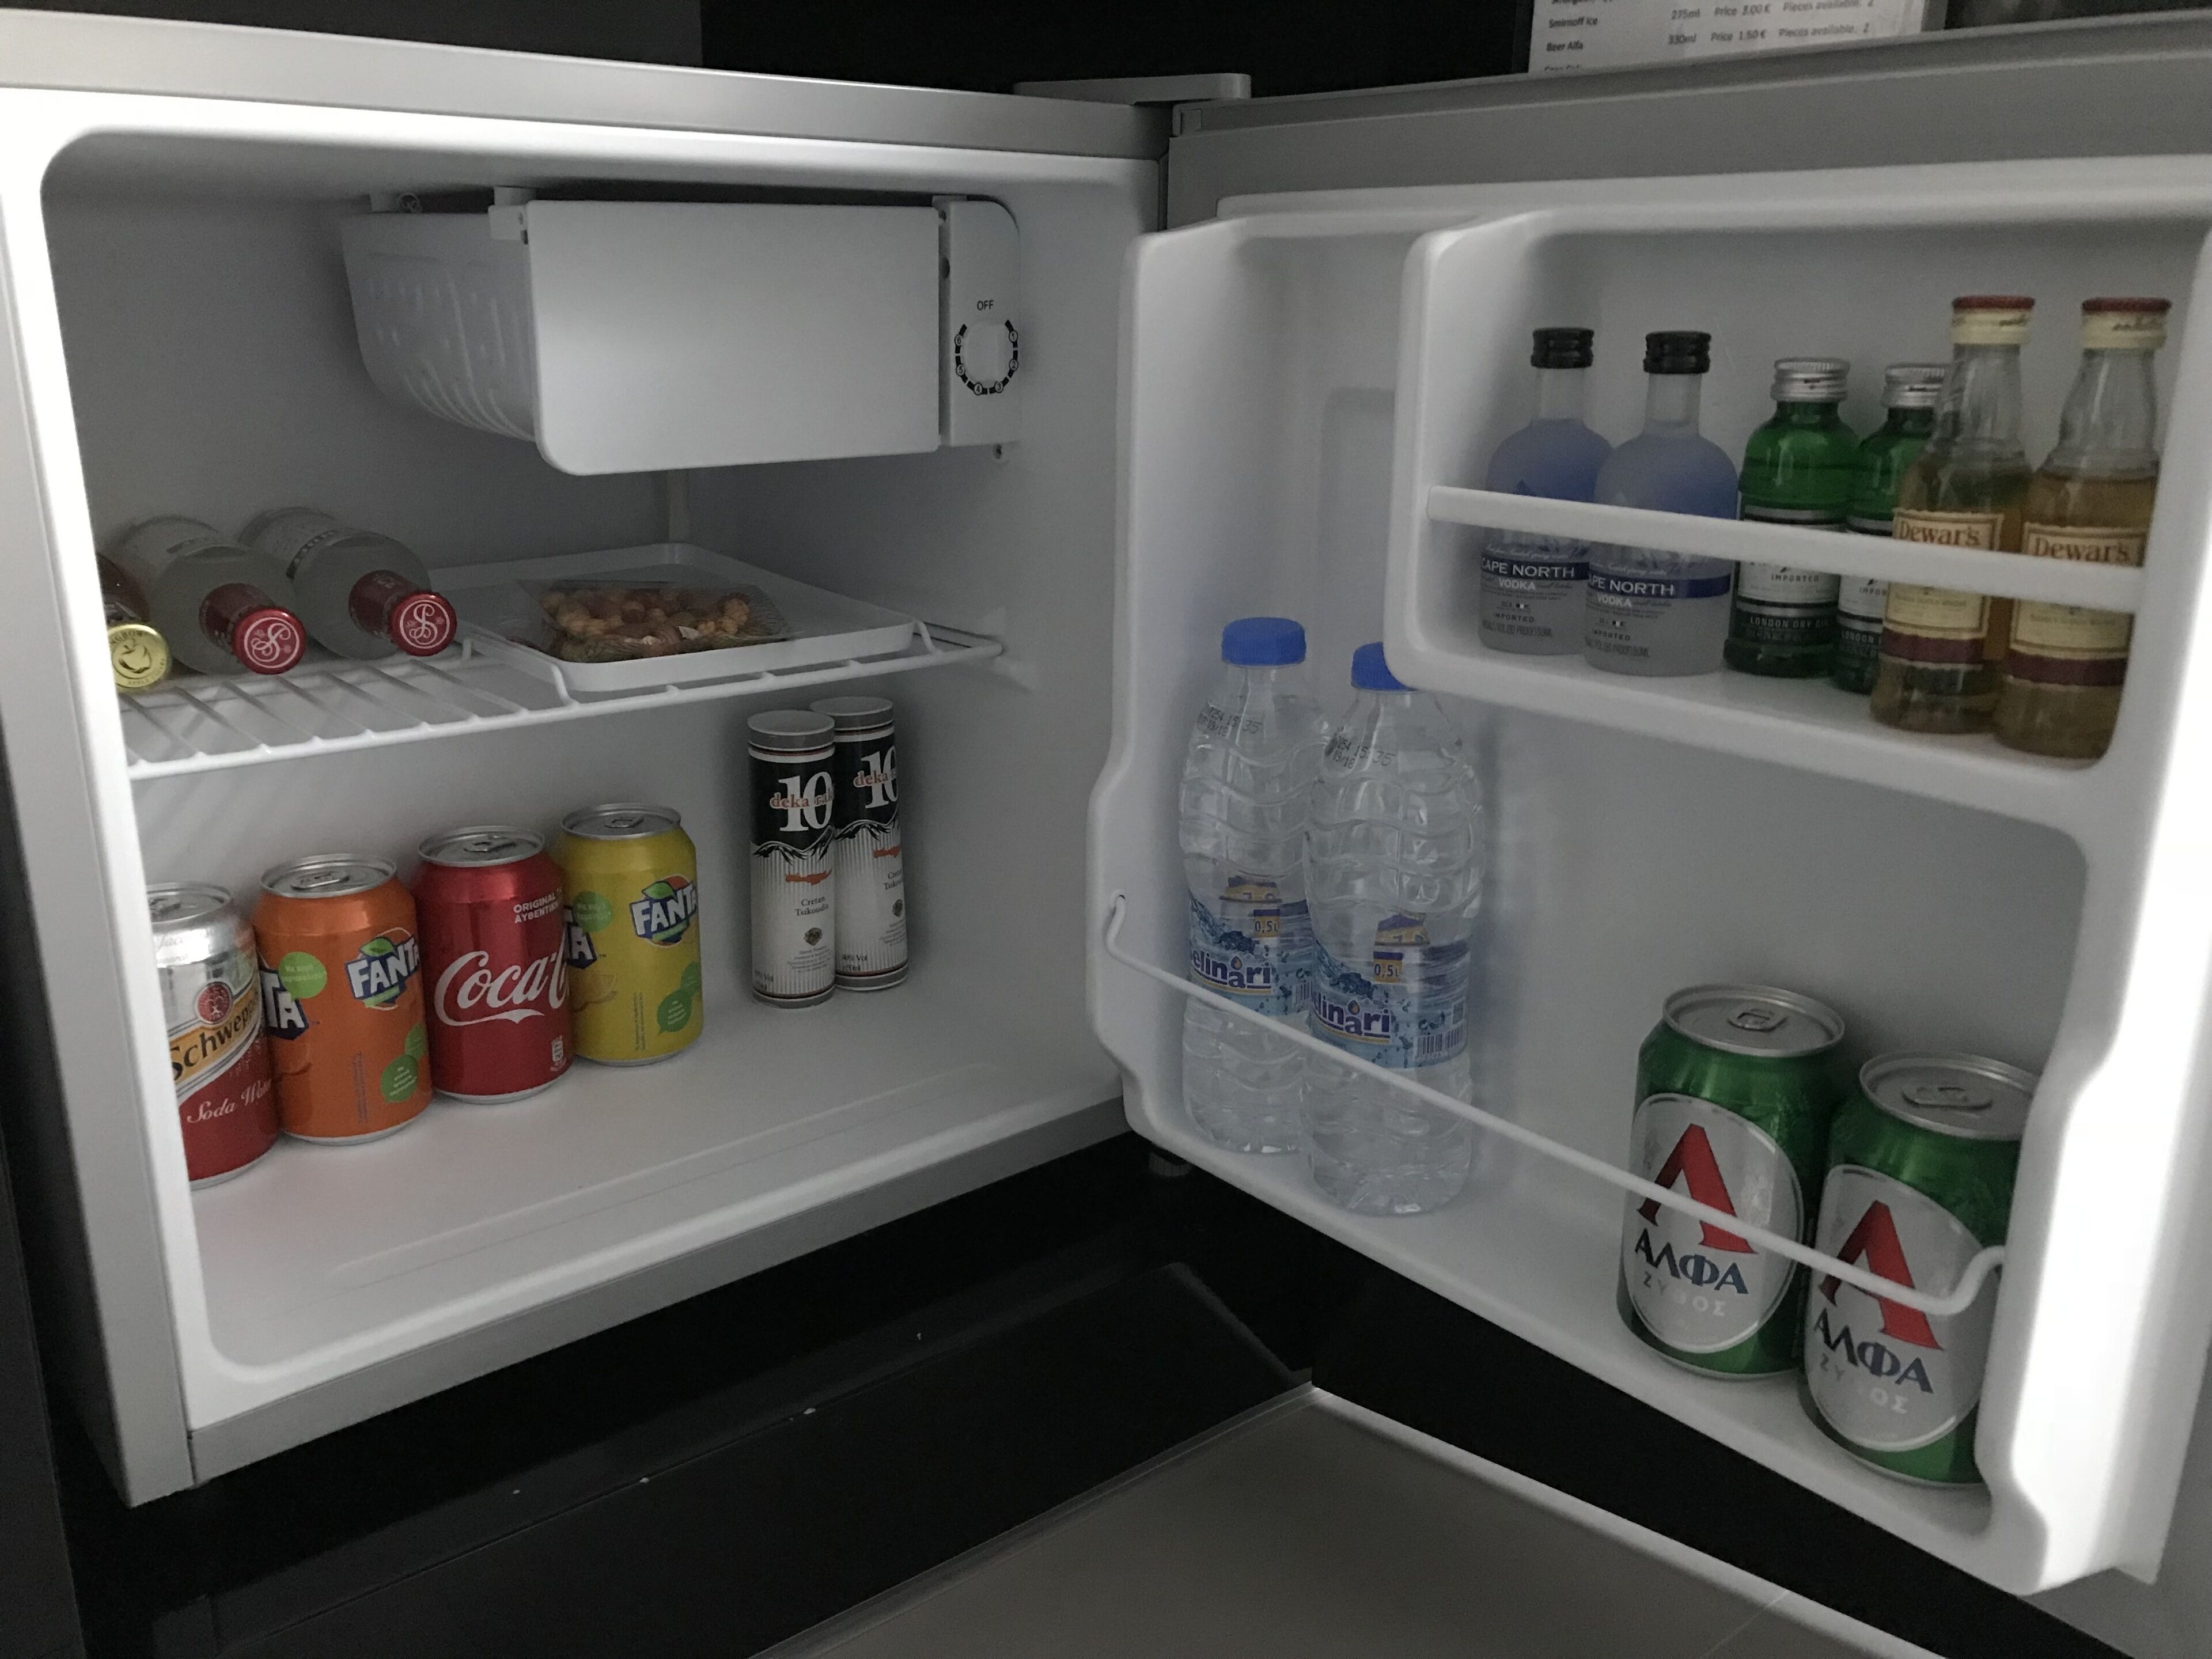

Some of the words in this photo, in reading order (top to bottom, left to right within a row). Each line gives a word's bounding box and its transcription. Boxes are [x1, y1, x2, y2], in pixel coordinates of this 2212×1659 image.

[1548, 16, 1585, 28] Smirnoff
[1671, 9, 1700, 20] 275ml
[1714, 6, 1737, 17] Price
[1783, 1, 1813, 12] Pieces
[1547, 41, 1565, 52] Beer
[1567, 40, 1584, 51] Alfa
[1669, 33, 1696, 45] 330ml
[1711, 32, 1733, 41] Price
[1739, 30, 1759, 41] 1.50
[1779, 28, 1809, 37] Pieces
[977, 300, 994, 310] OFF
[957, 337, 962, 345] 6
[959, 366, 963, 374] 5
[976, 385, 980, 393] 4
[997, 382, 1002, 391] 3
[1900, 520, 1982, 547] Dewar's
[2034, 538, 2130, 563] Dewar's
[1481, 556, 1508, 575] CAPE
[1512, 564, 1575, 578] NORTH
[1498, 578, 1536, 590] VODKA
[1771, 574, 1819, 583] IMPORTED
[1609, 579, 1674, 596] NORTH
[1597, 593, 1633, 608] VODKA
[1493, 612, 1535, 623] IMPORTED
[1750, 616, 1789, 628] LONDON
[1792, 619, 1810, 628] DRY
[1842, 630, 1874, 643] LONDON
[855, 770, 888, 786] deka
[861, 745, 898, 809] 10
[770, 793, 810, 808] deka
[778, 771, 834, 832] 10
[513, 892, 556, 914] ORIGINAL
[801, 896, 825, 907] Cretan
[796, 903, 830, 916] Tsikoudia
[186, 1097, 236, 1123] Soda
[1820, 1353, 1909, 1415] ΖΥΟΣ
